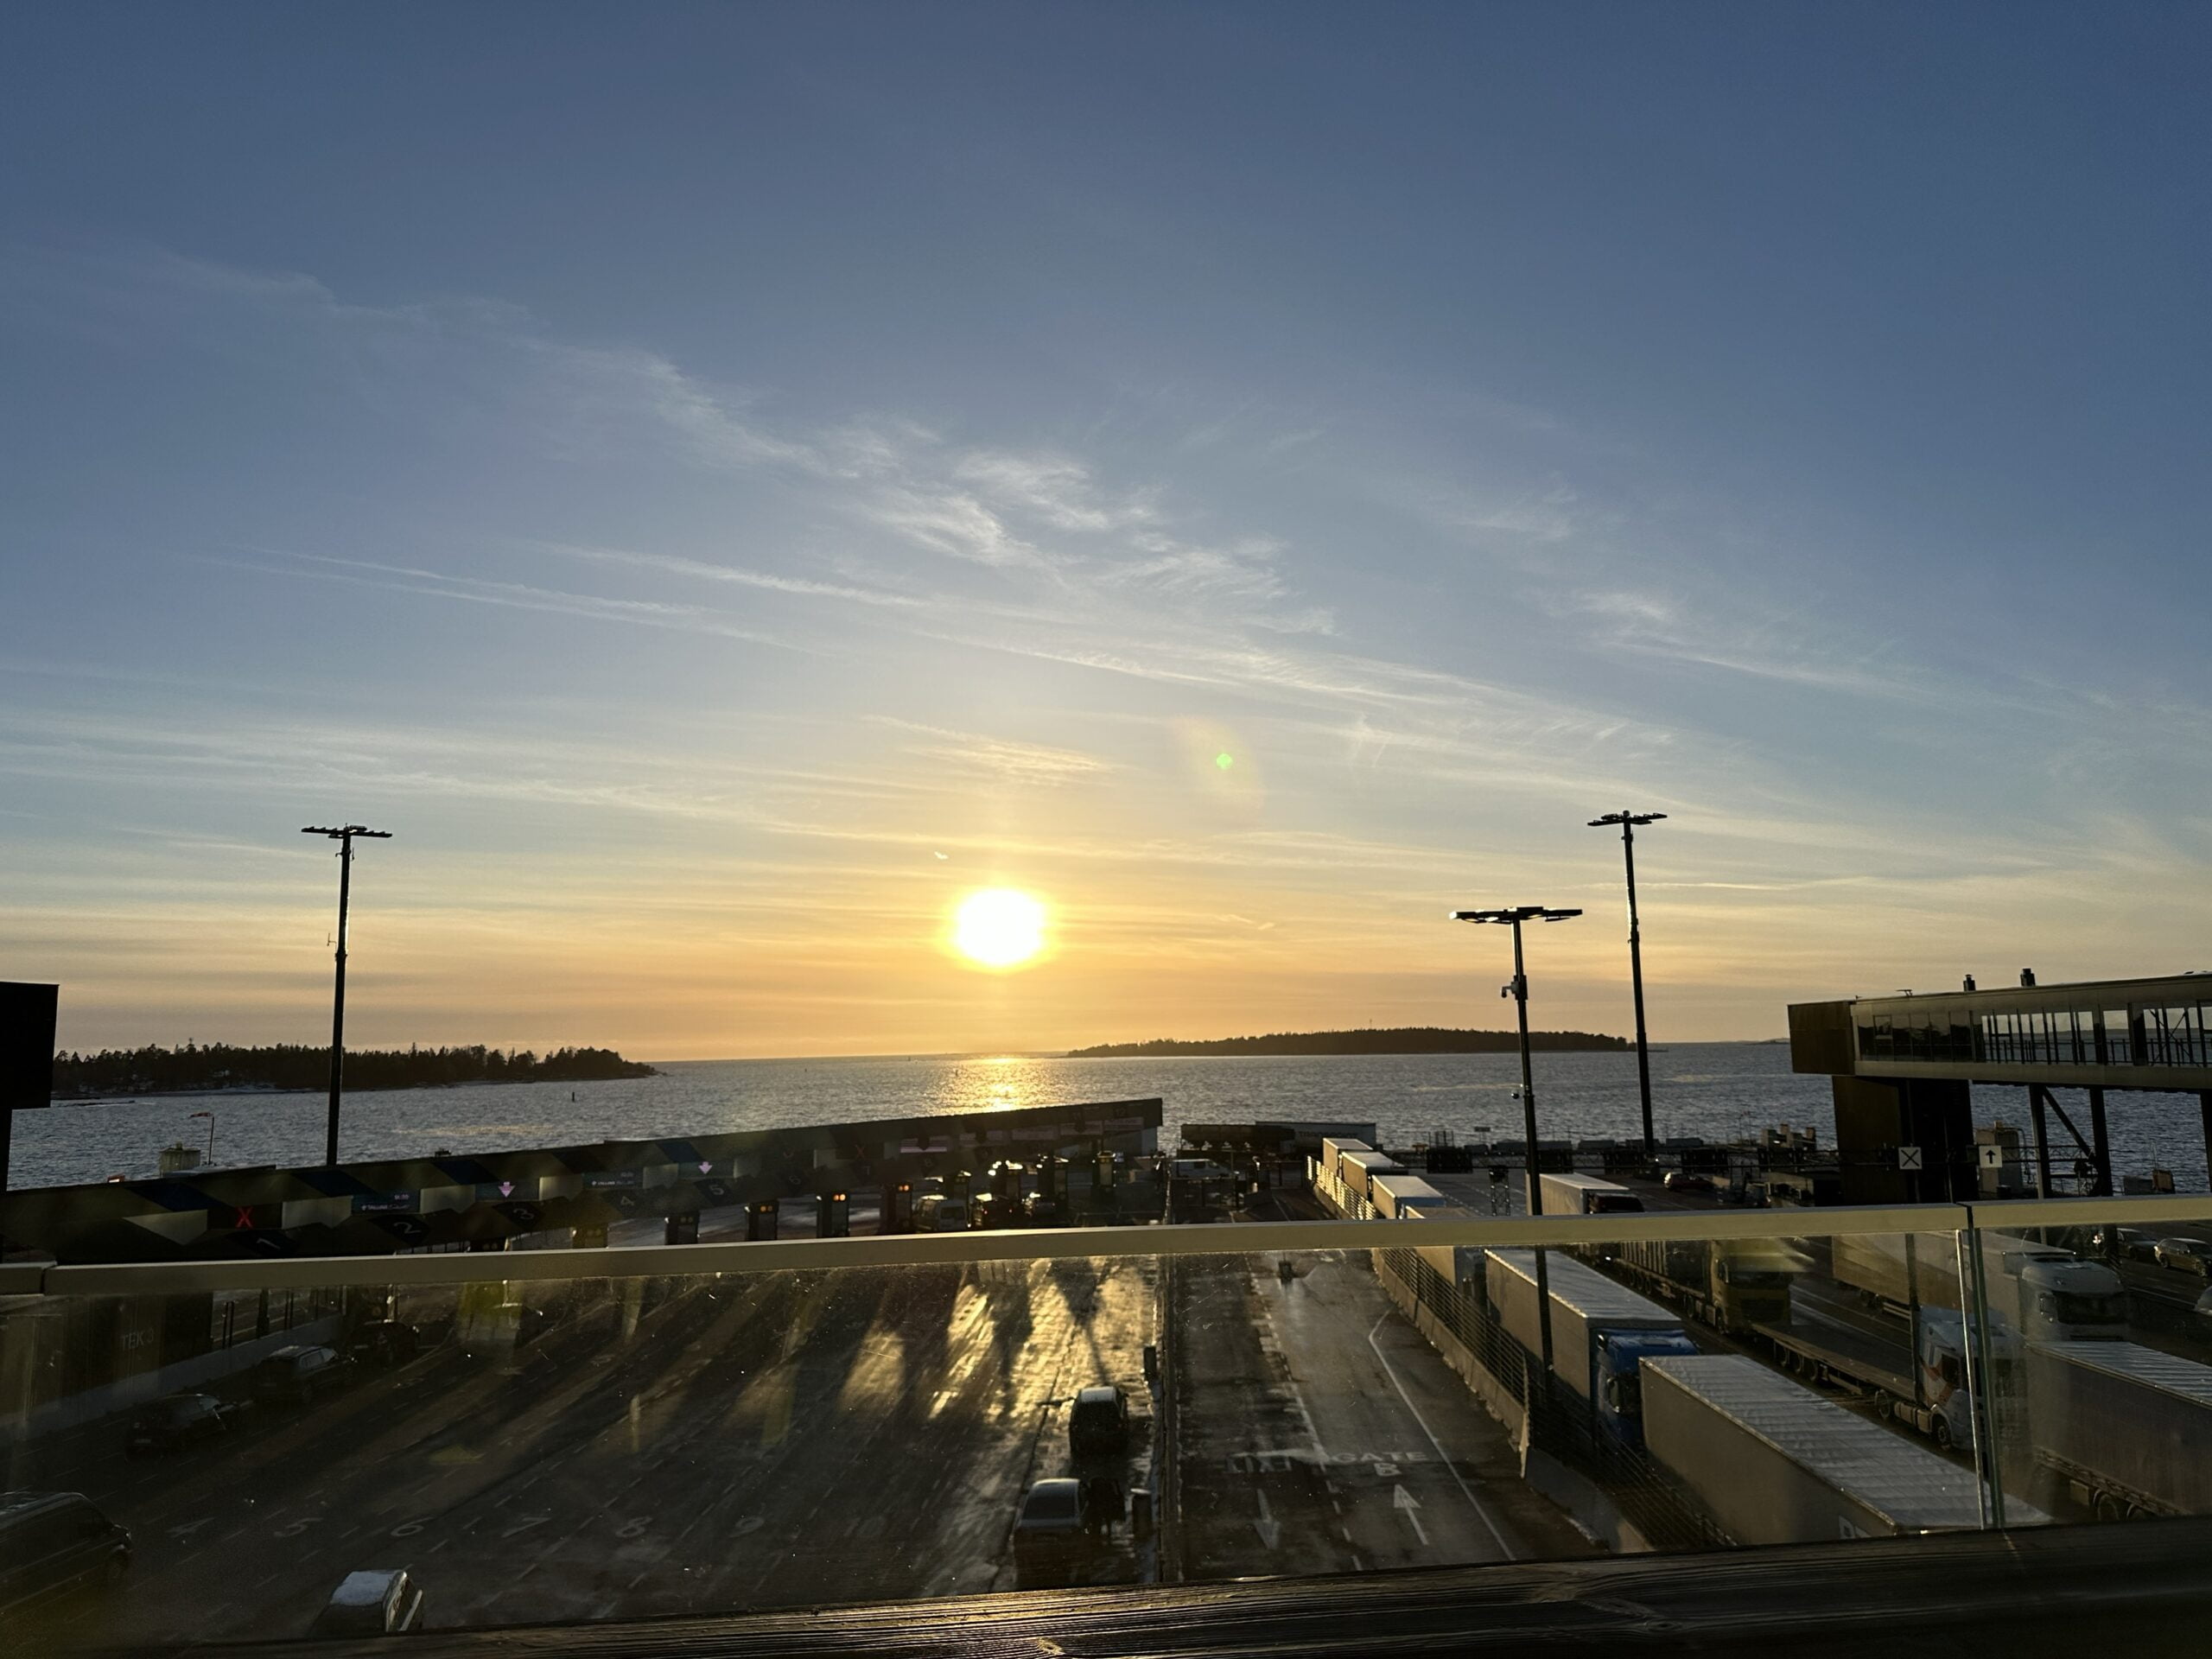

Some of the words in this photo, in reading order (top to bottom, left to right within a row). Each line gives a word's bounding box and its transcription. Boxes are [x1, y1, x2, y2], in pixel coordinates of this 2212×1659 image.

[789, 1175, 802, 1186] 6
[709, 1185, 724, 1196] 5
[620, 1195, 635, 1206] 4
[512, 1207, 535, 1220] 3
[393, 1221, 423, 1234] 2
[1331, 1452, 1431, 1465] GATE
[1374, 1462, 1402, 1477] B
[165, 1517, 215, 1538] 4
[273, 1516, 324, 1537] 5
[390, 1516, 435, 1537] 6
[502, 1517, 551, 1538] 7
[614, 1516, 653, 1538] 8
